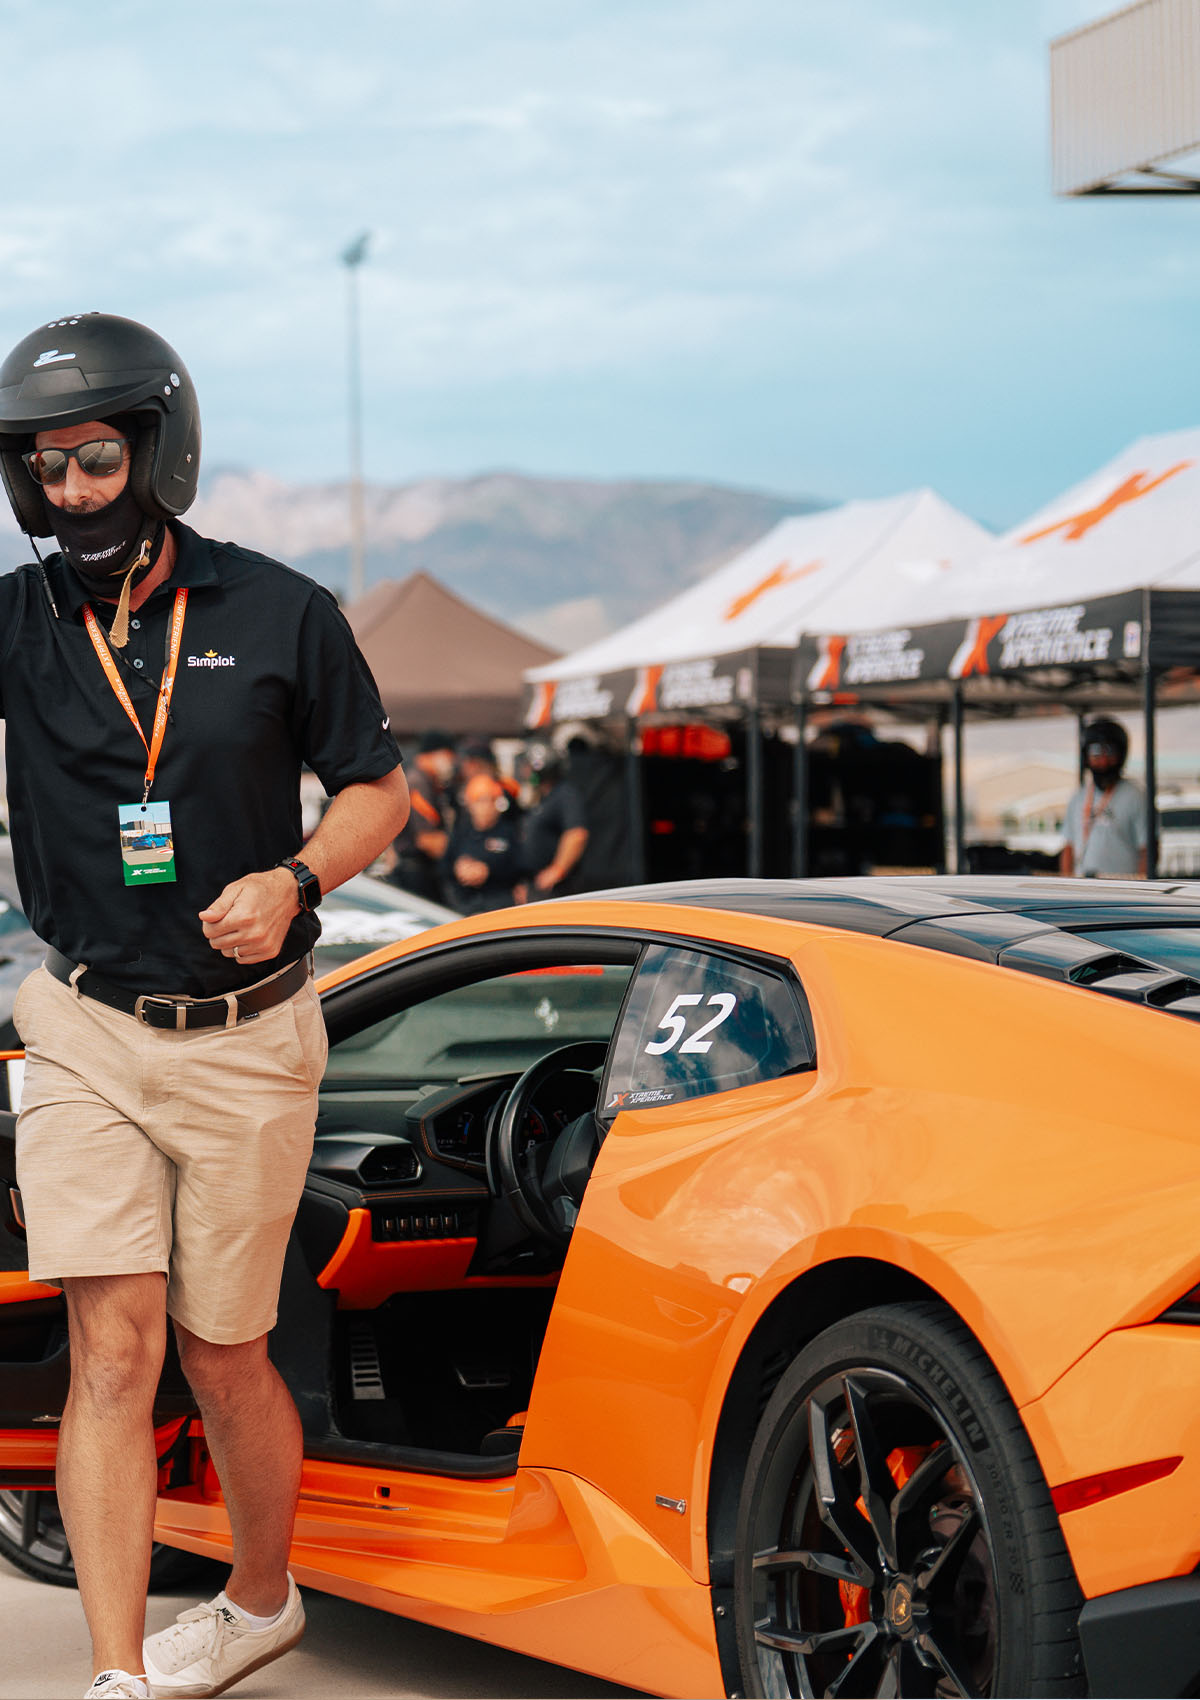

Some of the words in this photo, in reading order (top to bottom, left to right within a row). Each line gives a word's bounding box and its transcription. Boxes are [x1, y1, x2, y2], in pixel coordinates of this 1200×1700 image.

[187, 655, 236, 670] Simplot
[644, 992, 737, 1056] 52
[628, 1090, 664, 1099] XTREME
[629, 1094, 675, 1104] XPERIENCE
[891, 1335, 986, 1444] MICHELIN
[221, 1607, 238, 1622] NIKE
[97, 1672, 115, 1683] NIKE
